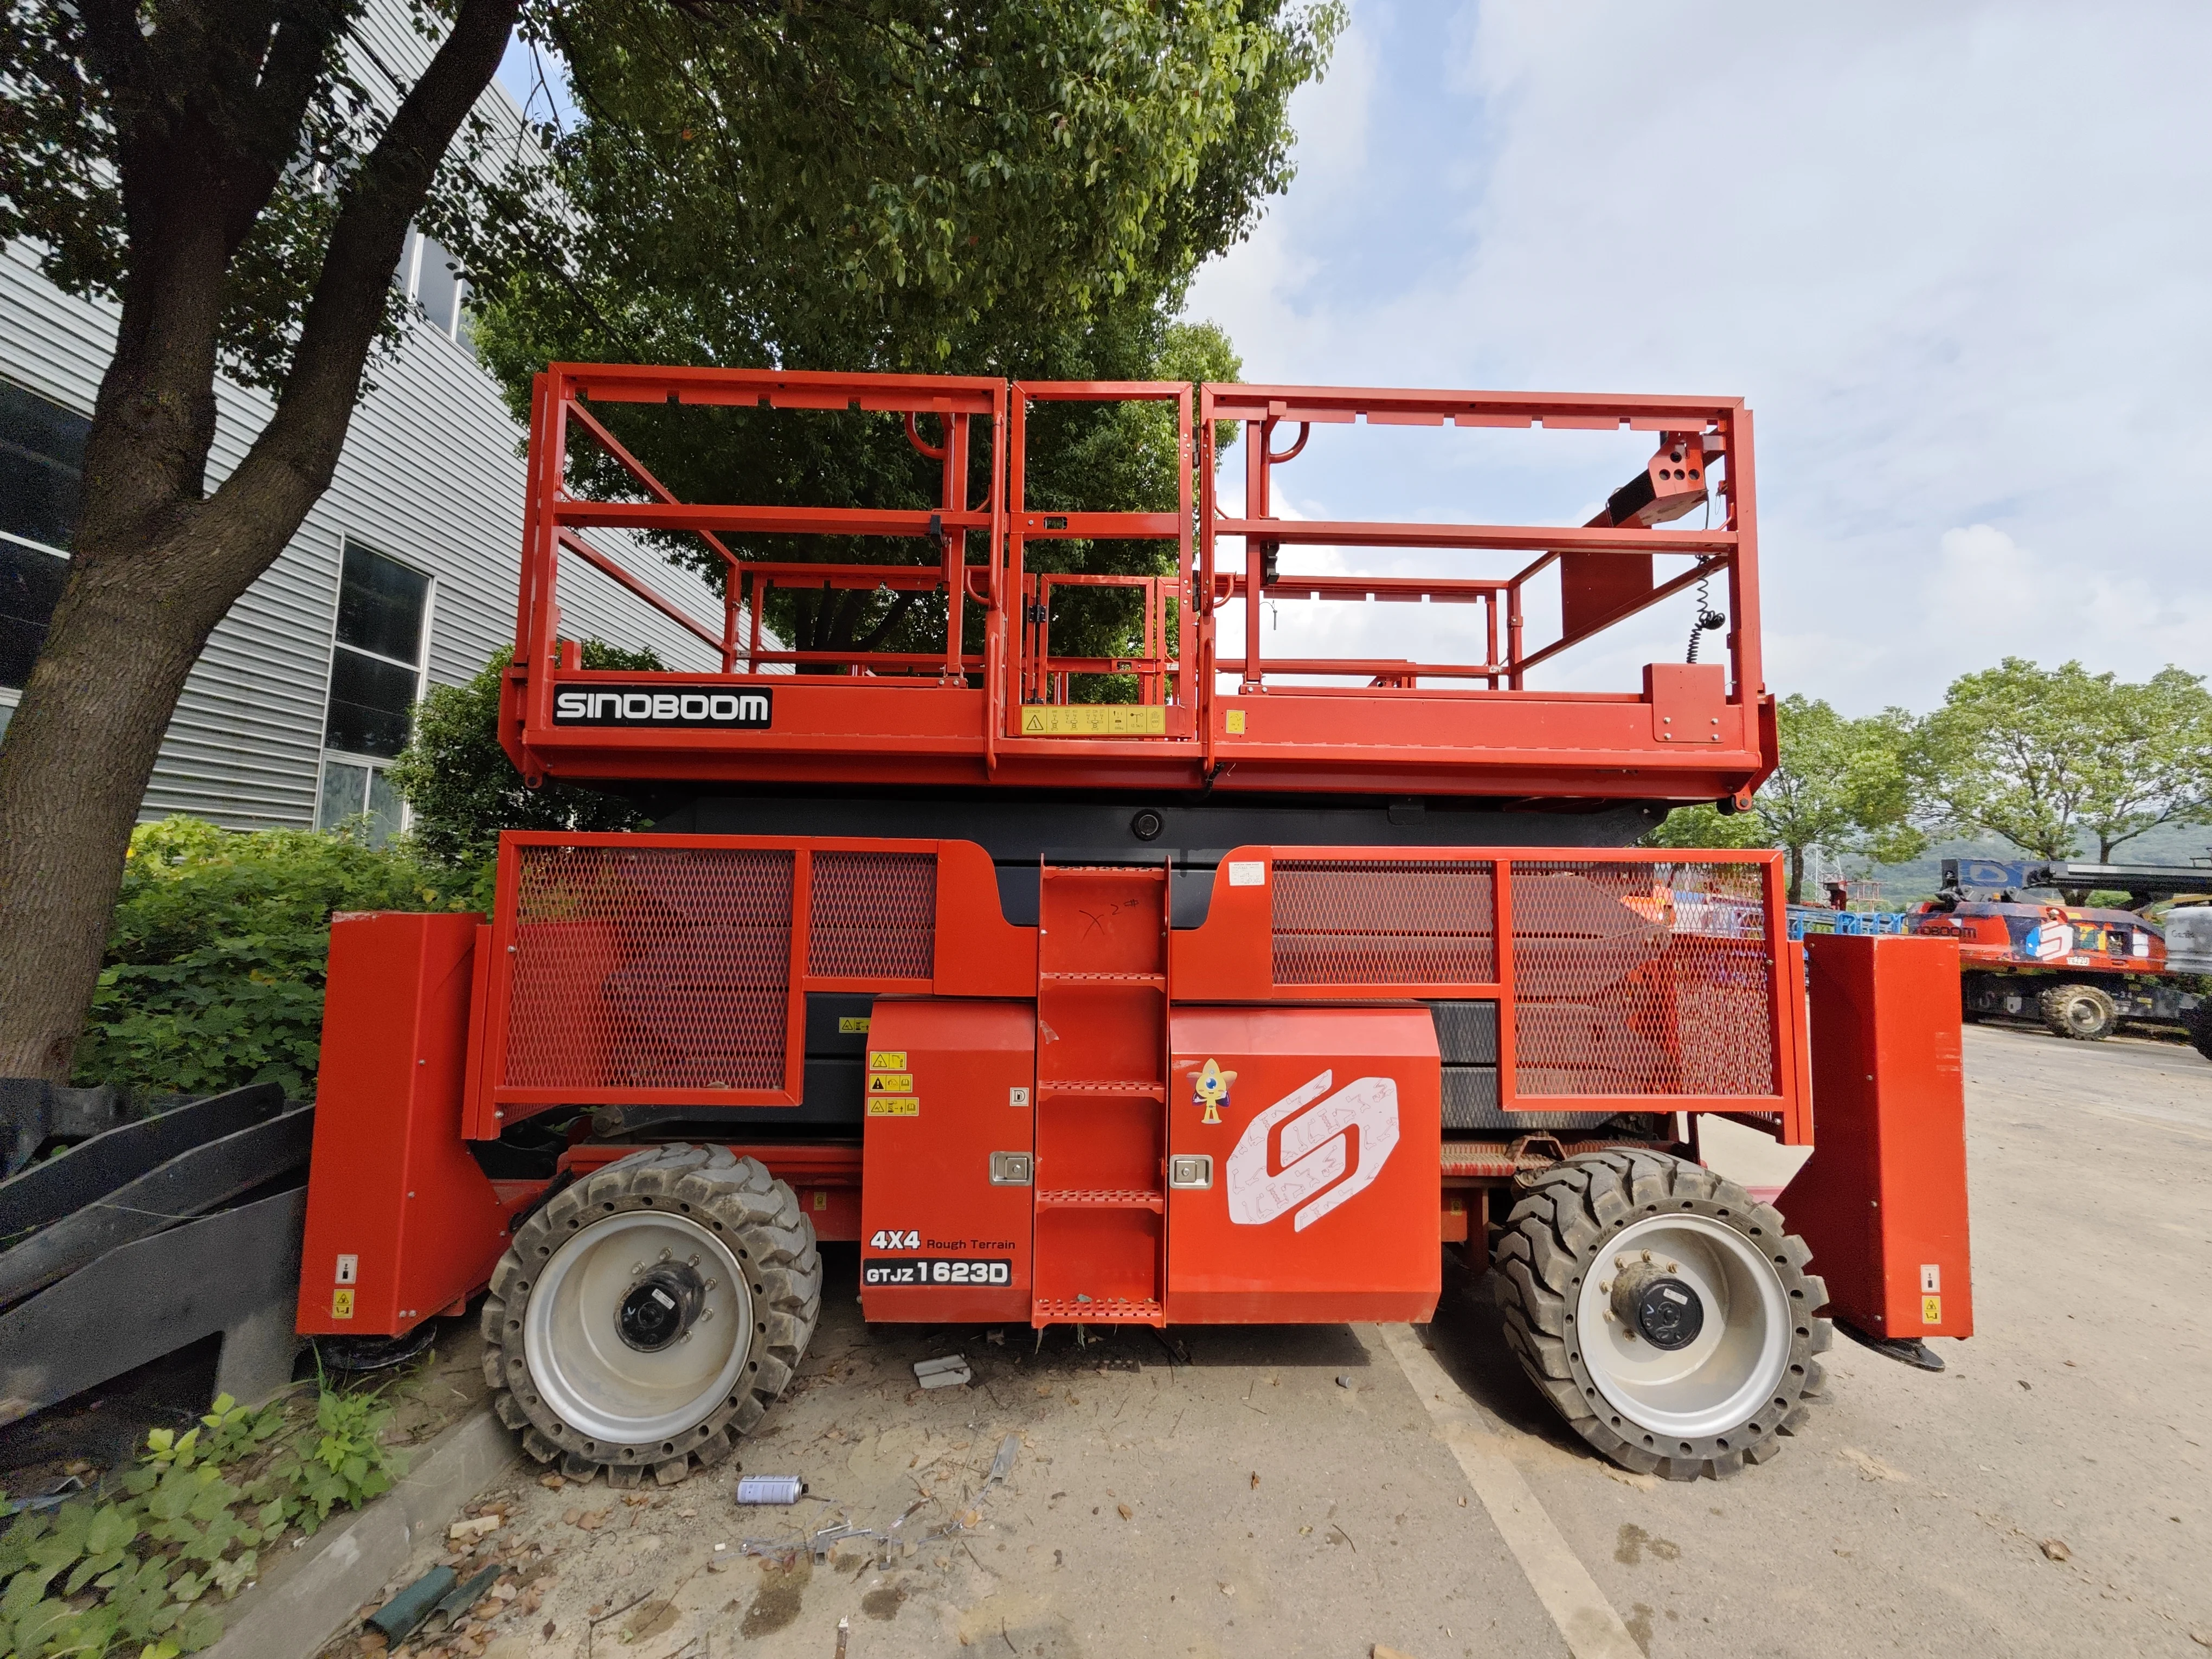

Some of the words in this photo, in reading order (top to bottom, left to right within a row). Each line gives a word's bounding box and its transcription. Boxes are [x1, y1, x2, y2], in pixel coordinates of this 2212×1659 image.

[557, 693, 768, 721] SINOBOOM
[871, 1231, 921, 1249] 4X4
[927, 1240, 966, 1250] Rough
[970, 1239, 1015, 1249] Terrain
